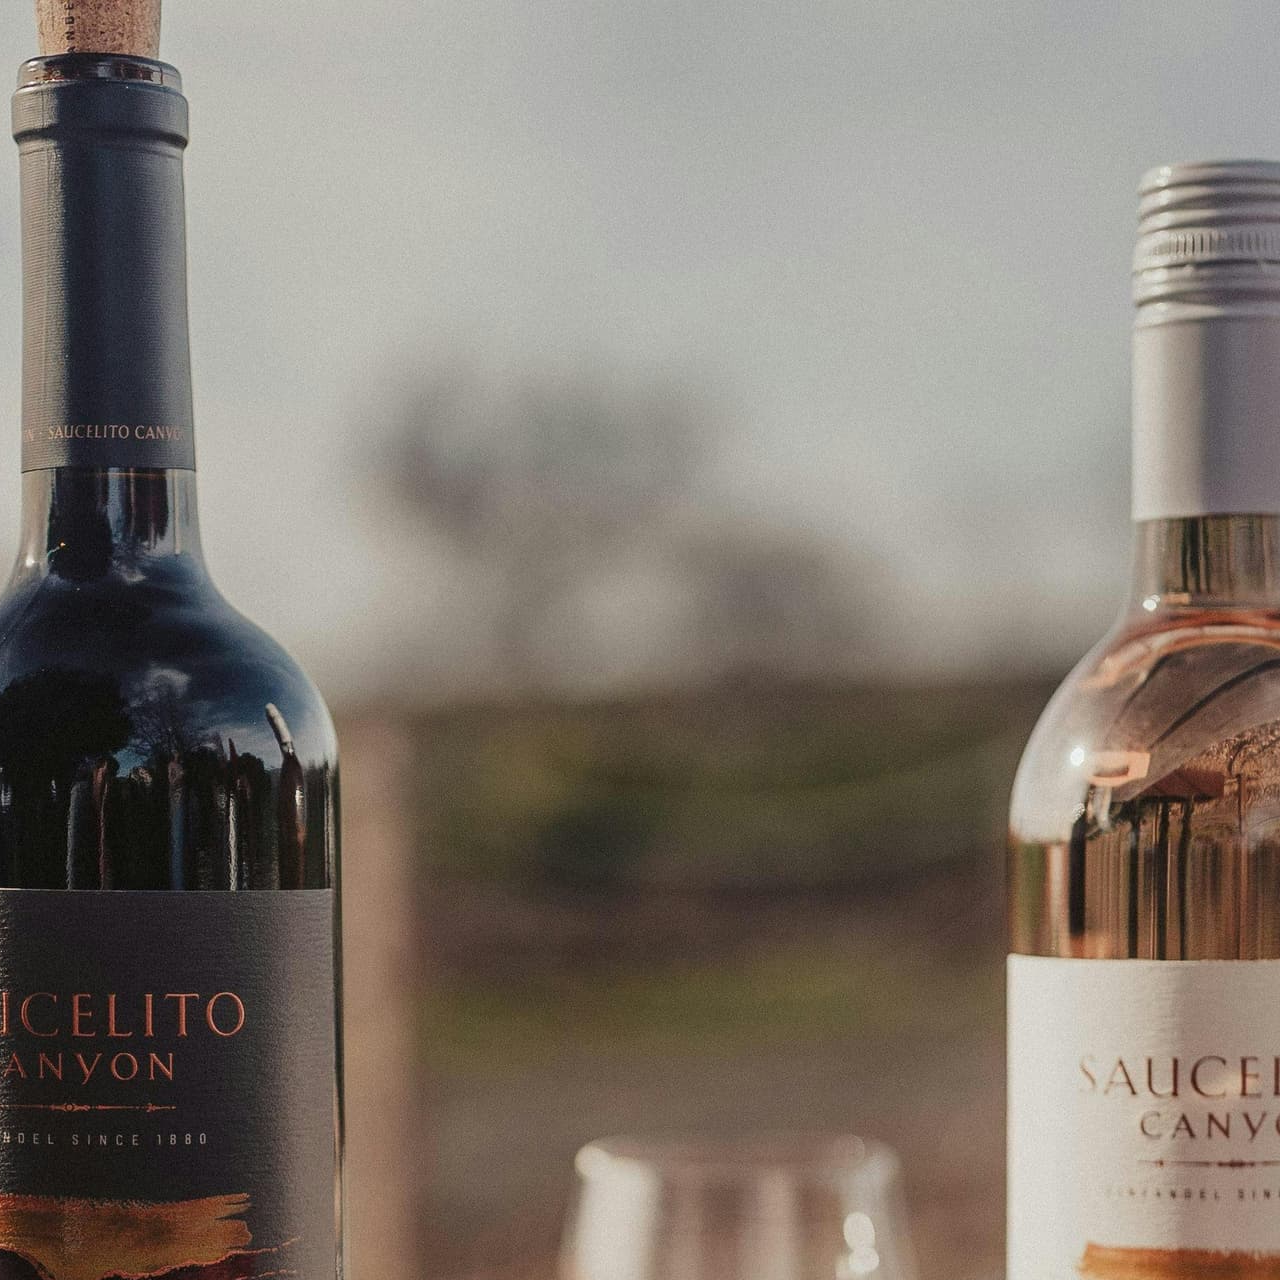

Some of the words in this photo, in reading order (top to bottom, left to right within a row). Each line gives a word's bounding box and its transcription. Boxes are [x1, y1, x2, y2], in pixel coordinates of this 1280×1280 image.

[47, 424, 130, 440] SAUCELITO
[134, 424, 184, 442] CANYO
[71, 1133, 140, 1147] SINCE
[157, 1132, 208, 1146] 1880
